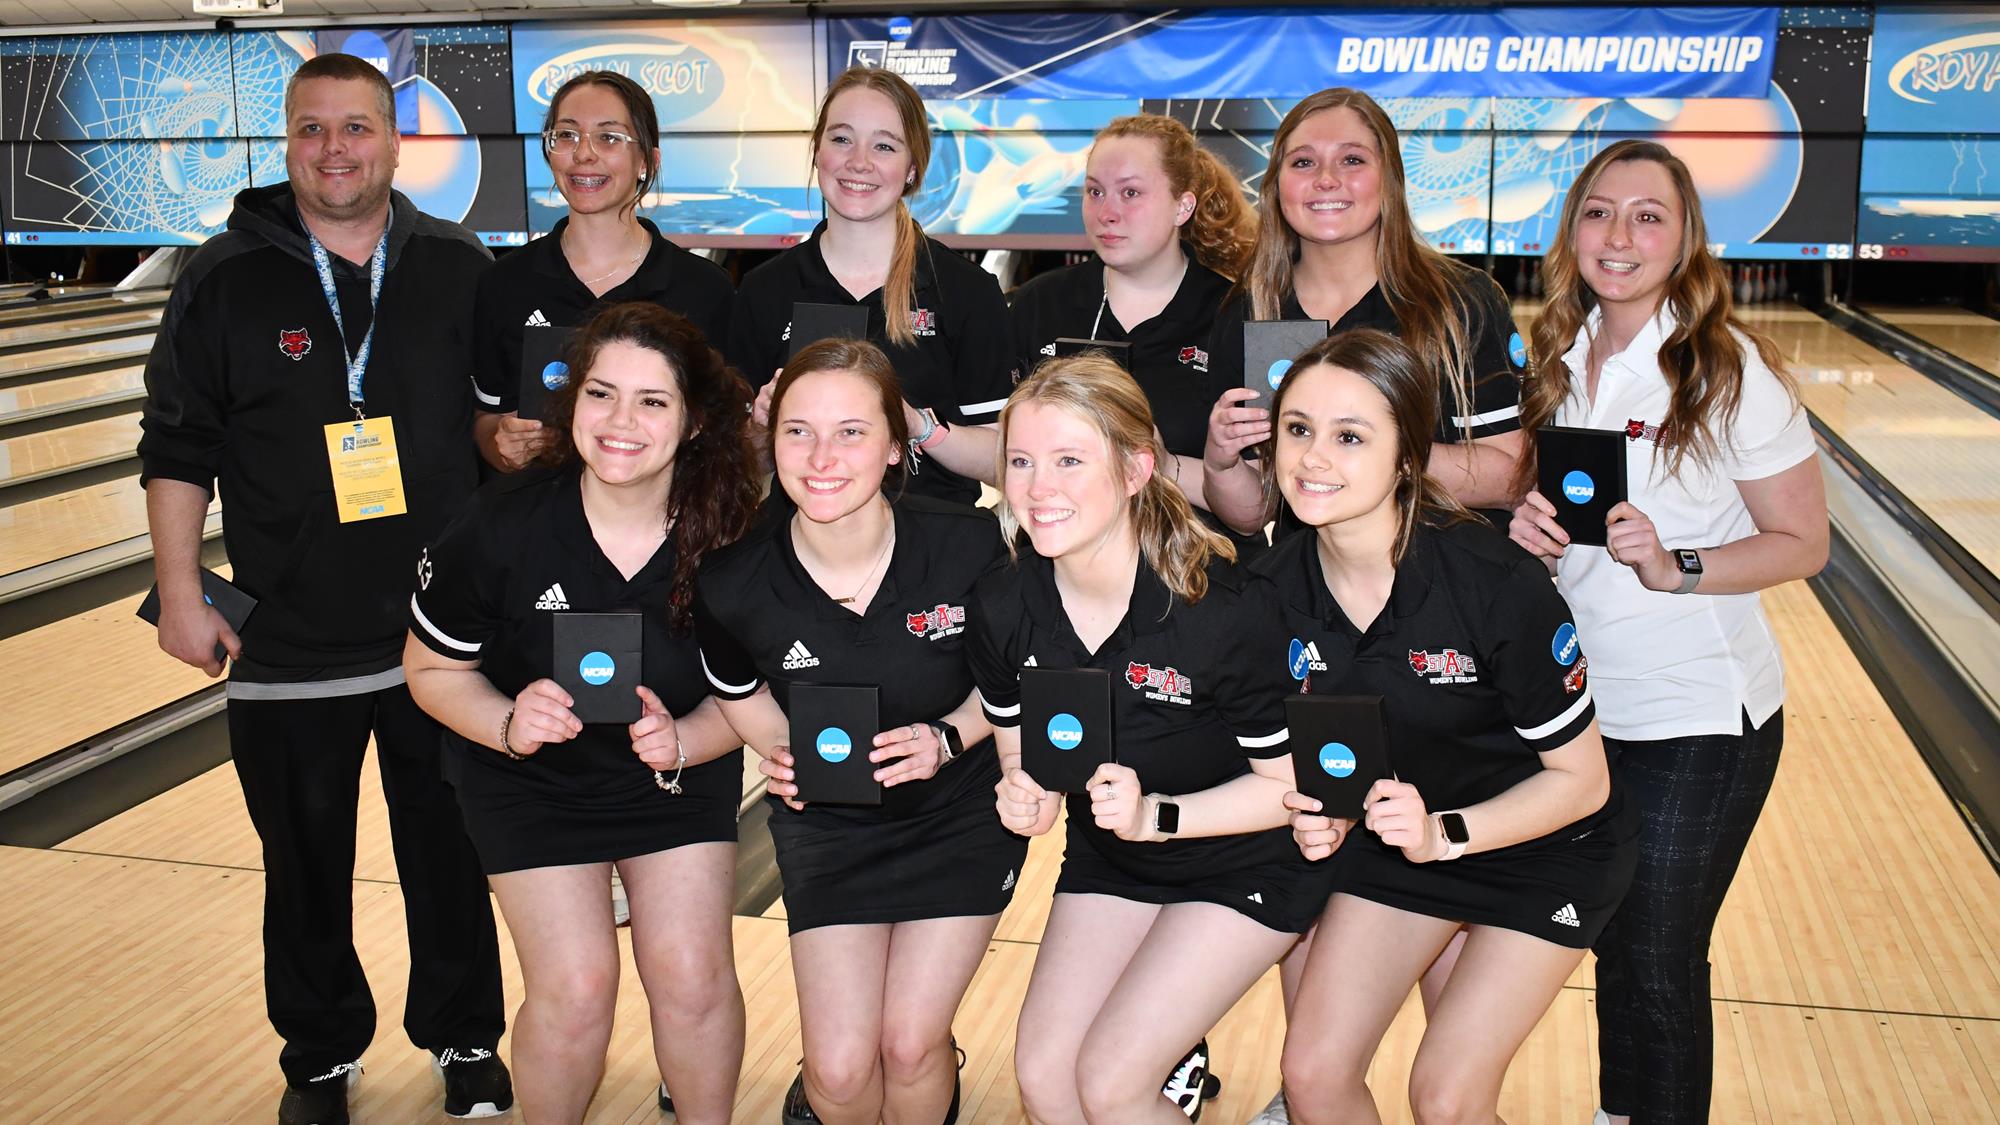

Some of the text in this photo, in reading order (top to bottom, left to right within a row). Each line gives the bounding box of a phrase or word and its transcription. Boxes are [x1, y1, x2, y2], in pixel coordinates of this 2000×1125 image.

[1336, 37, 1763, 73] BOWLING CHAMPIONSHIP
[640, 59, 720, 96] SCOT
[7, 232, 21, 244] 41
[1463, 239, 1485, 254] 50
[1494, 239, 1515, 254] 51
[1825, 243, 1850, 259] 52
[1859, 244, 1884, 259] 53
[1566, 485, 1594, 497] NCAA
[535, 600, 570, 610] adidas
[1558, 633, 1578, 662] NCAA
[783, 656, 820, 670] adidas
[1309, 660, 1327, 671] das
[1428, 649, 1476, 676] STATE
[583, 667, 614, 677] NCAA
[1149, 667, 1192, 696] STATE
[1051, 729, 1083, 741] NCAA
[820, 743, 850, 754] NCAA
[1324, 758, 1356, 769] NCAA
[1551, 914, 1580, 927] adidas
